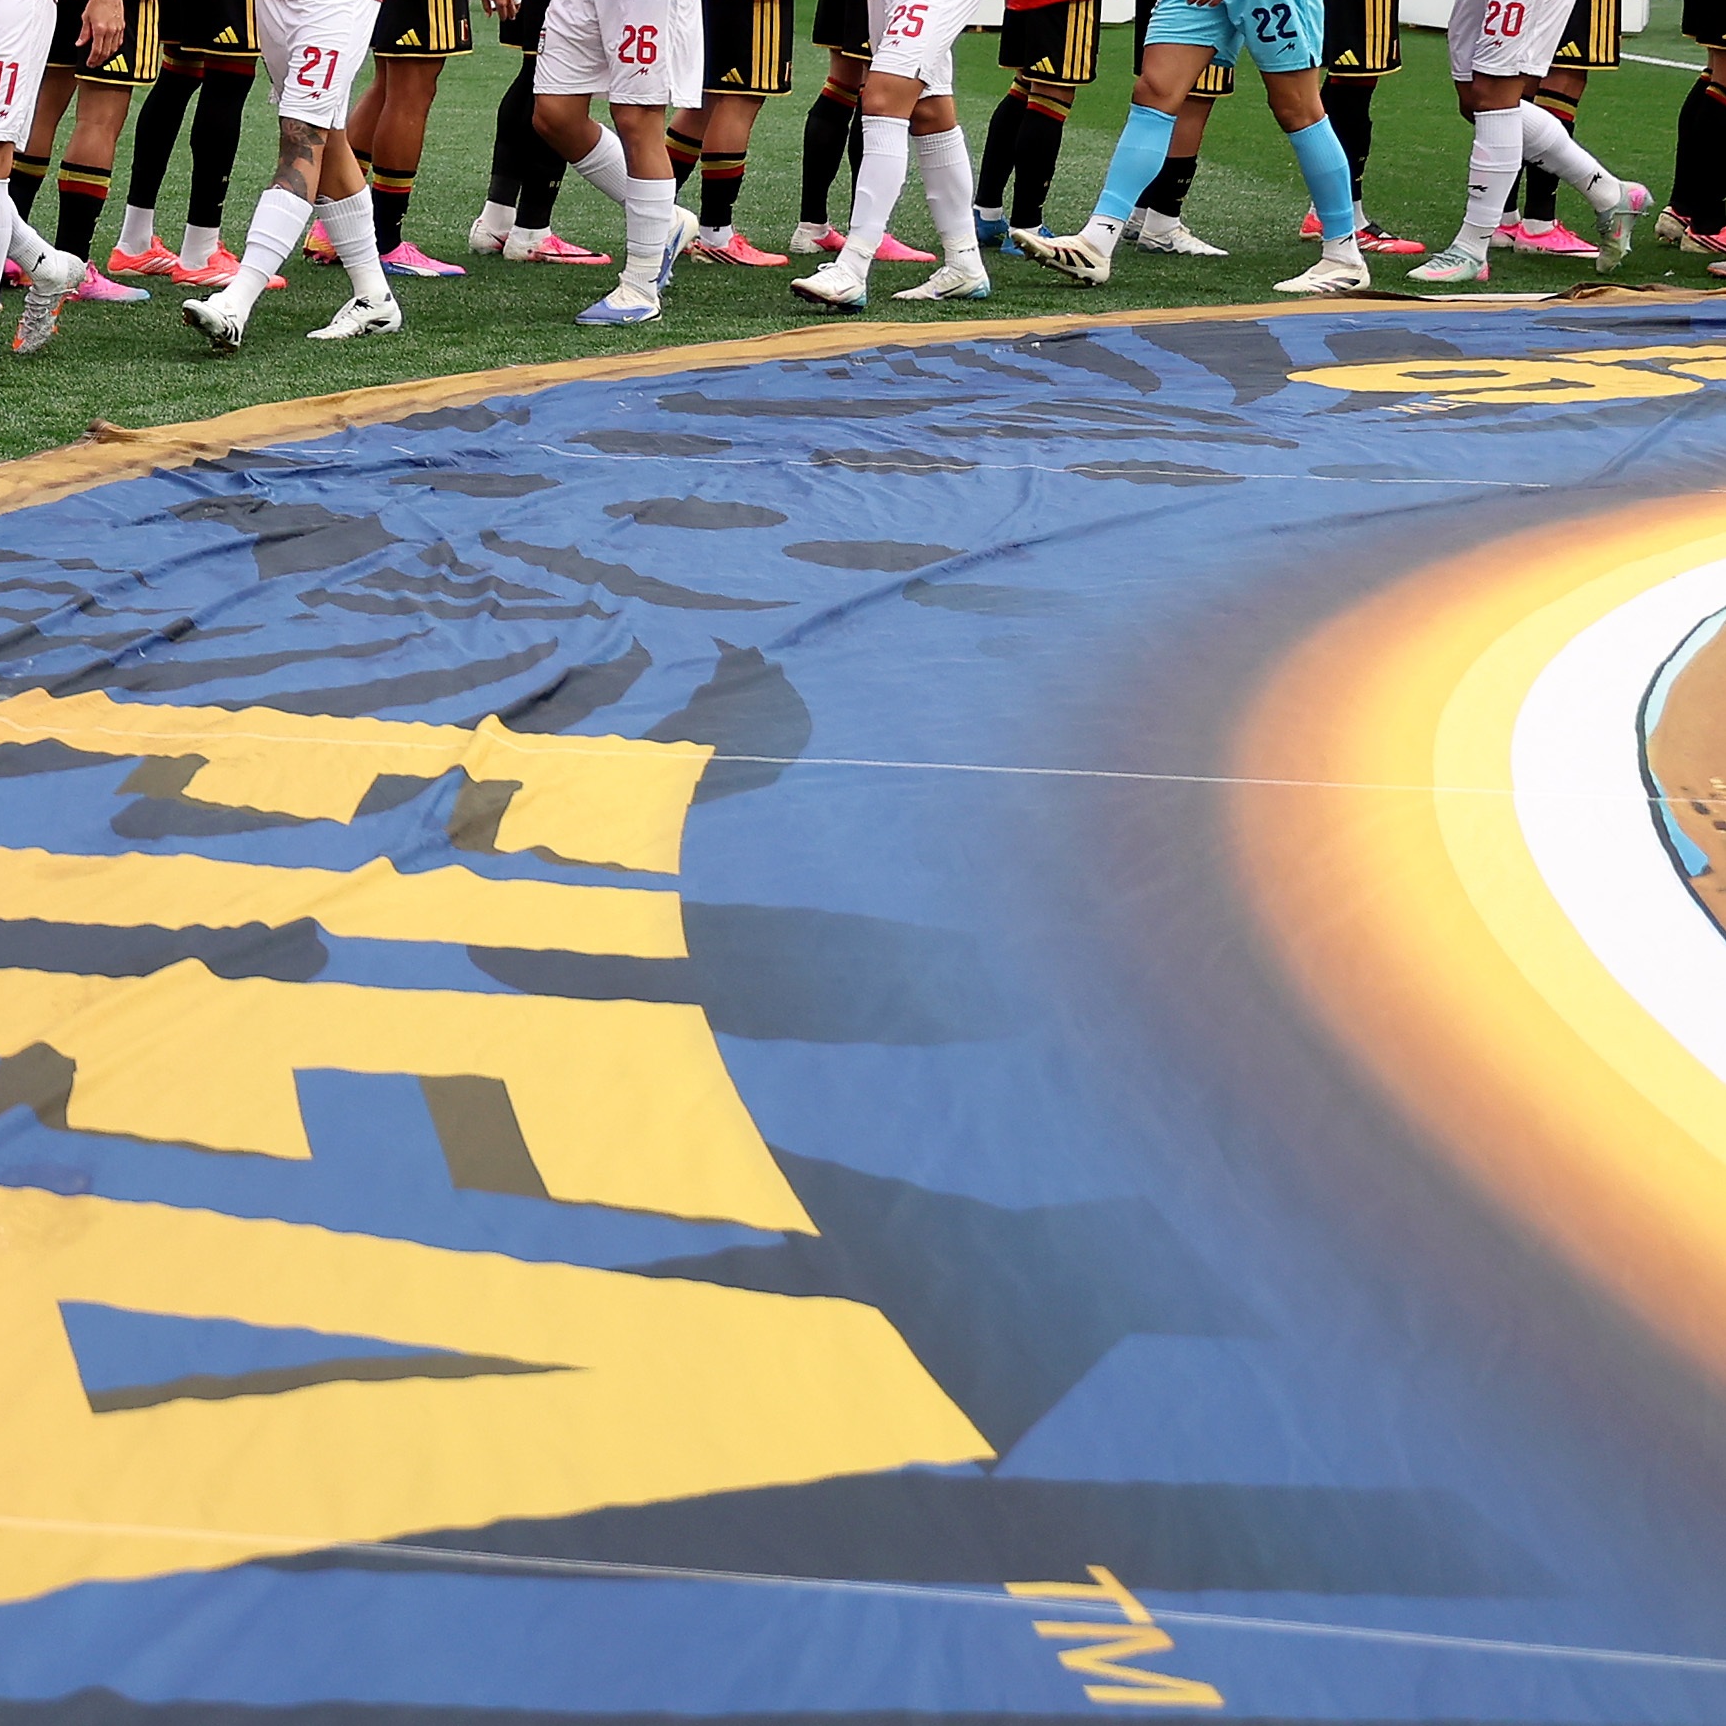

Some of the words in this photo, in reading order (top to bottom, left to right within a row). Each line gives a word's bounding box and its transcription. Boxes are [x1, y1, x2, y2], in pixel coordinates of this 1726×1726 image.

[888, 3, 929, 39] 25
[1252, 3, 1298, 43] 22
[1484, 1, 1525, 38] 20
[618, 24, 659, 65] 26
[297, 46, 340, 90] 21
[1005, 1564, 1225, 1710] TM
